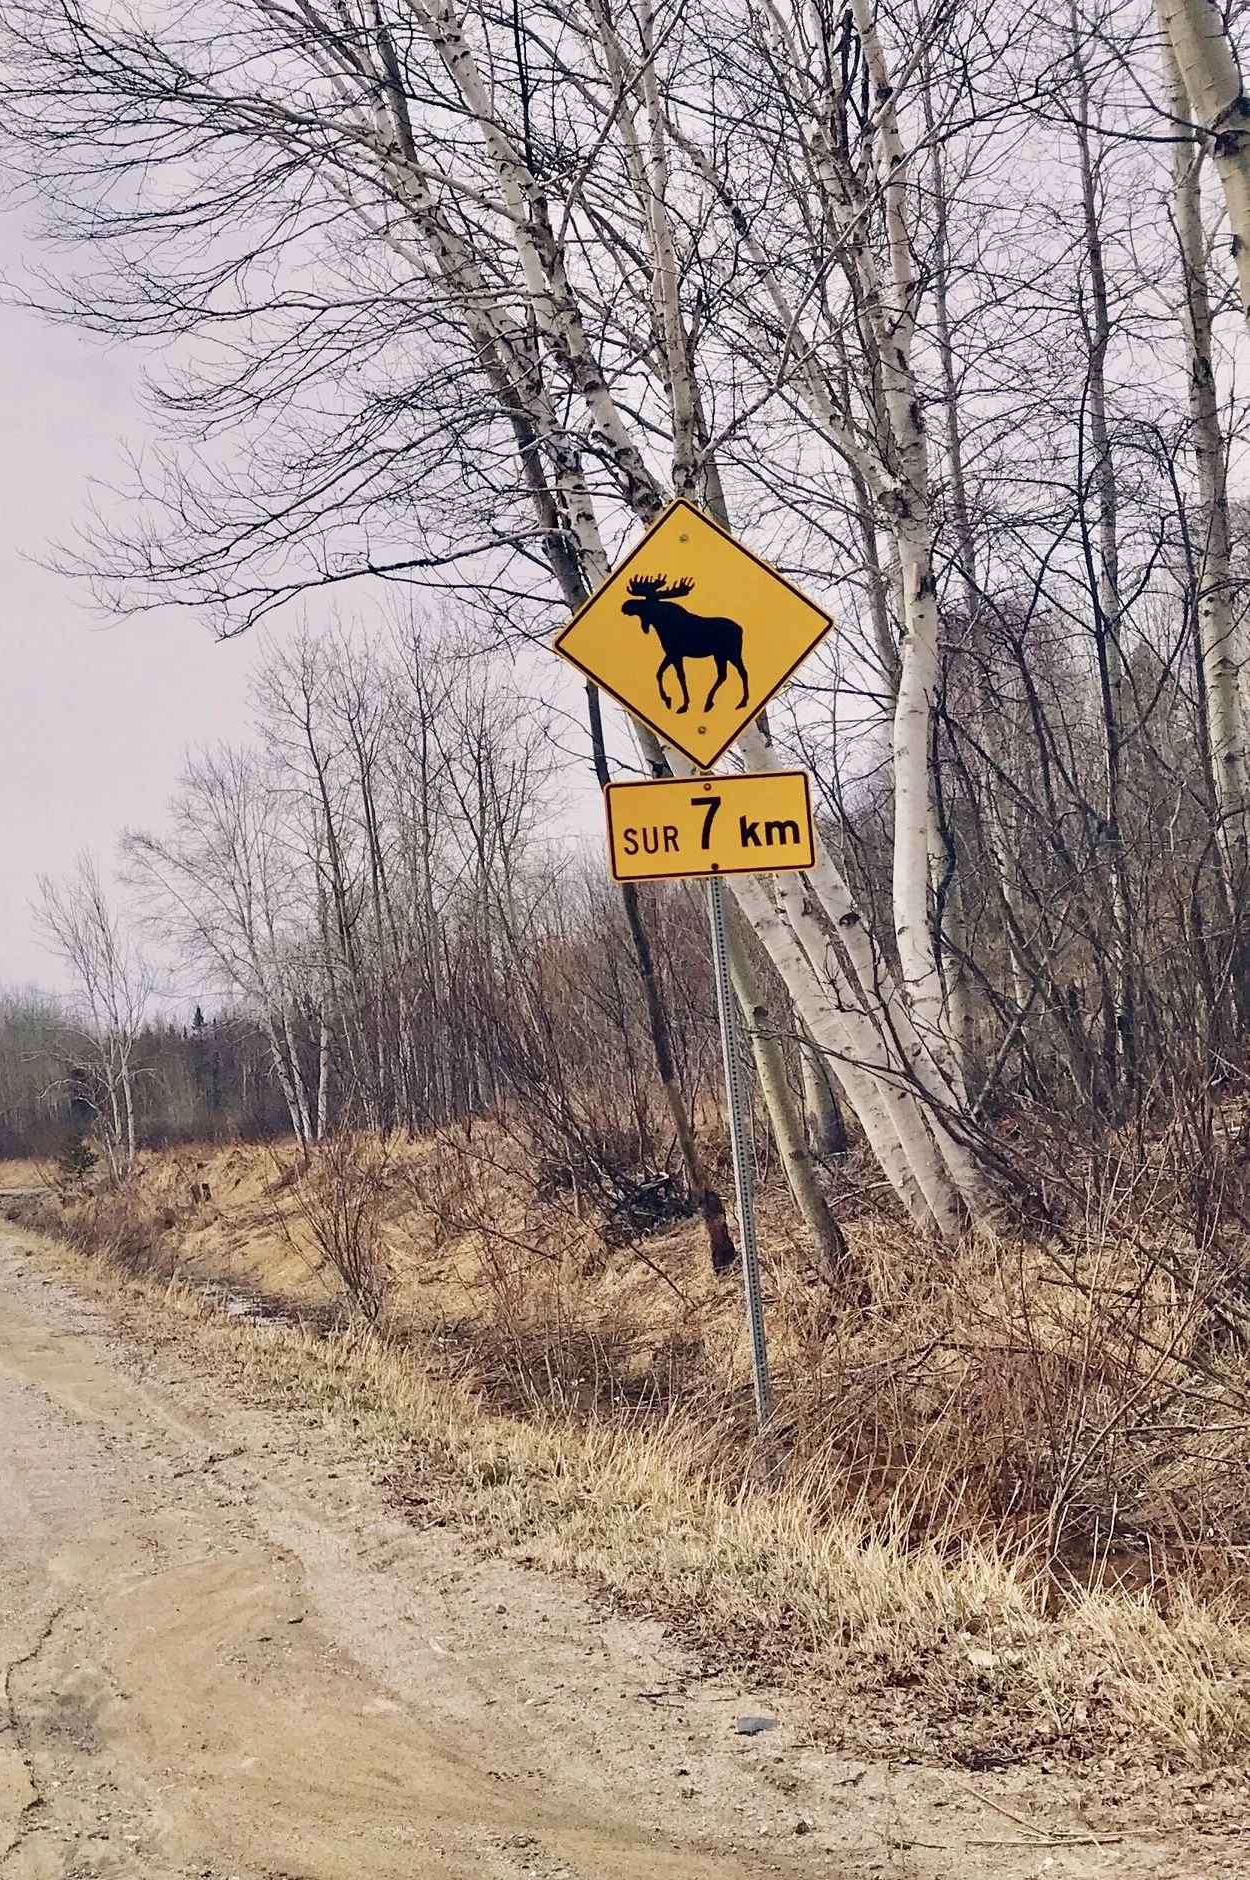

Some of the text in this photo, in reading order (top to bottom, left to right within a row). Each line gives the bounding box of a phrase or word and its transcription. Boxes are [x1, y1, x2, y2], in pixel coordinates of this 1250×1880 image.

[622, 796, 801, 856] SUR 7 km
